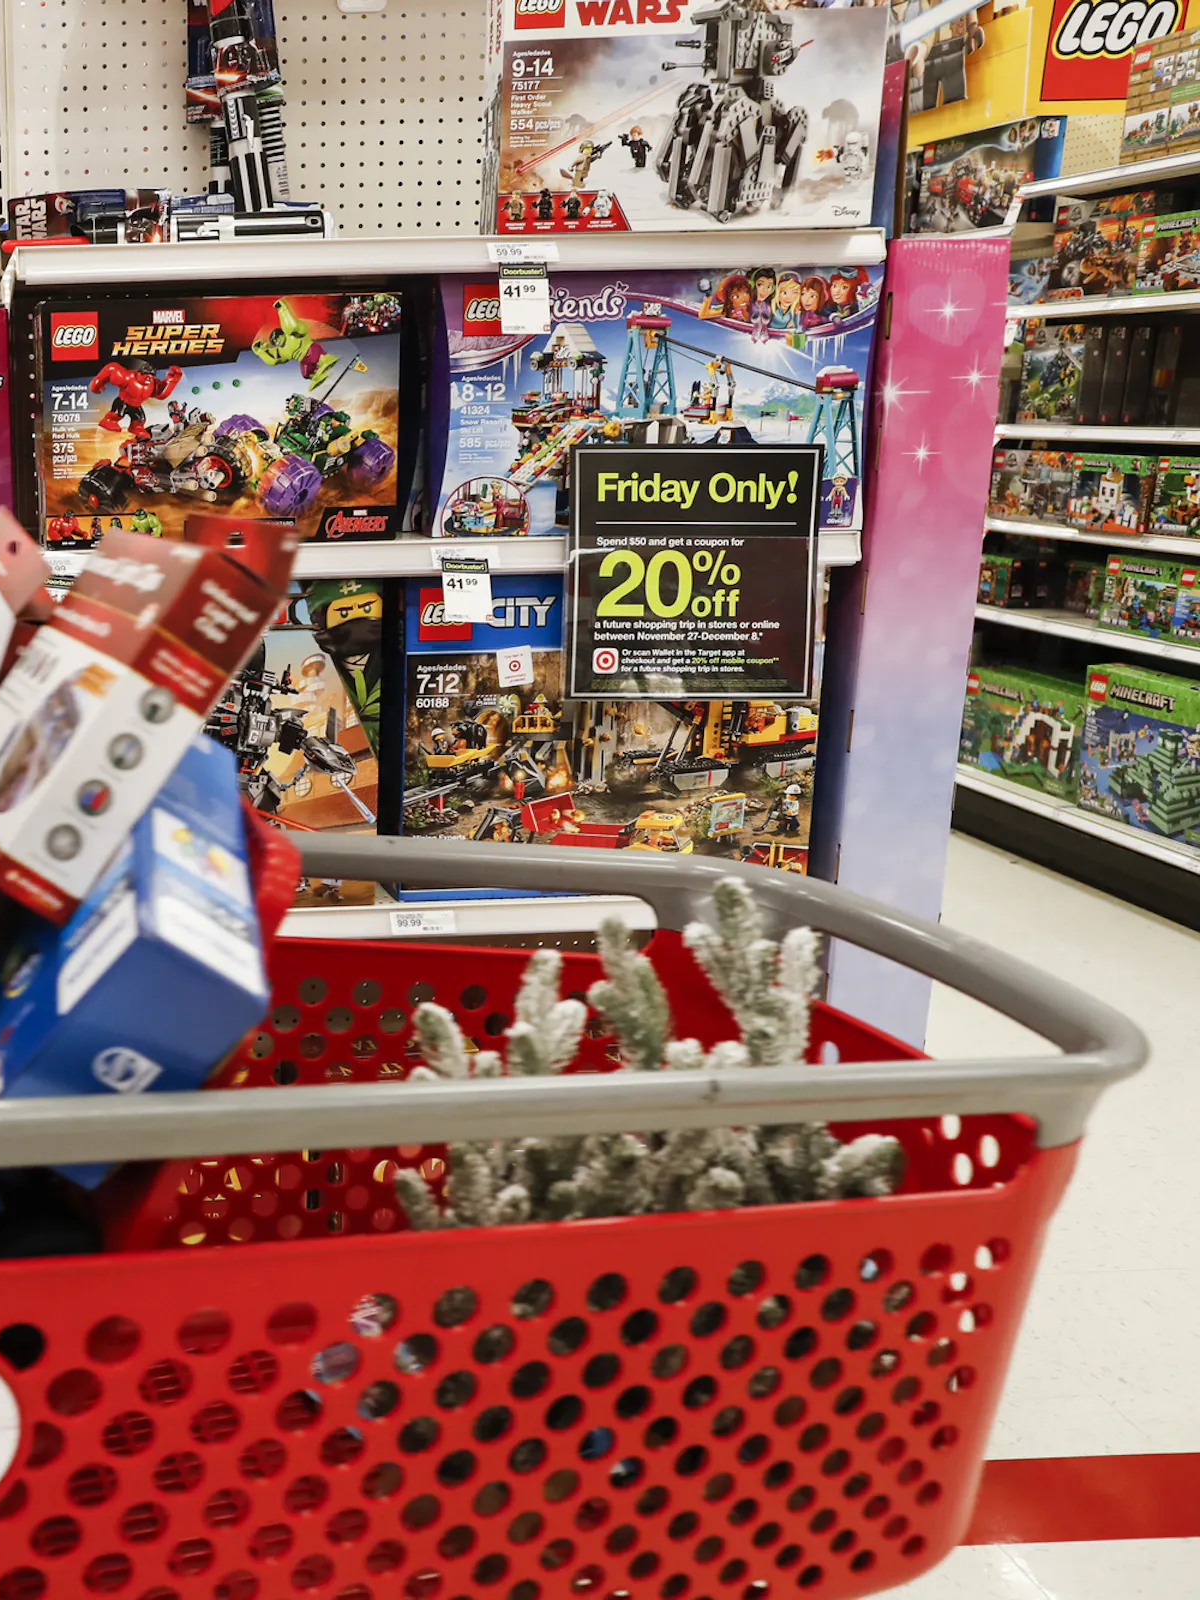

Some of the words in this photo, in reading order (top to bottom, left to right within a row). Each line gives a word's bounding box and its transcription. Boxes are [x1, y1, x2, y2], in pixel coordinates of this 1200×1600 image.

[576, 0, 689, 26] WARS
[1058, 1, 1176, 52] LEGO
[512, 57, 554, 78] 9-14
[511, 81, 540, 91] 75177
[527, 93, 547, 101] Order
[510, 119, 533, 131] 554
[831, 205, 860, 218] Disney
[496, 248, 522, 257] 59.99
[503, 268, 543, 276] Doorbuster!
[503, 285, 521, 298] 41
[523, 285, 536, 293] 99
[153, 310, 185, 323] MARVEL
[466, 301, 500, 321] LEG
[54, 326, 95, 346] LEGO
[125, 324, 221, 341] SUPER
[111, 339, 225, 356] HEROES
[461, 383, 506, 402] 8-12
[51, 392, 89, 411] 7-14
[460, 405, 490, 415] 41324
[52, 413, 80, 423] 76078
[52, 442, 75, 454] 375
[459, 437, 481, 448] 585
[597, 472, 700, 509] Friday
[708, 470, 799, 510] Only!
[325, 510, 389, 538] AVENGERS
[596, 536, 628, 547] Spend
[629, 537, 646, 546] $50
[648, 537, 667, 546] and
[668, 537, 684, 548] get
[686, 538, 692, 546] a
[693, 538, 730, 548] coupon
[731, 537, 745, 546] for
[445, 562, 484, 571] Doorbuster!
[446, 578, 463, 590] 41
[596, 549, 742, 618] 20%
[691, 589, 740, 618] off
[490, 596, 556, 628] CITY
[594, 621, 601, 629] a
[602, 620, 631, 629] future
[633, 620, 677, 631] shopping
[679, 620, 696, 631] trip
[697, 620, 707, 629] in
[708, 620, 737, 629] stores
[751, 620, 780, 629] online
[594, 632, 635, 641] between
[637, 632, 685, 641] November
[687, 632, 748, 641] 27-December
[697, 649, 721, 658] Target
[722, 650, 736, 658] app
[417, 664, 467, 672] Ages/edades
[672, 658, 684, 666] get
[662, 666, 696, 674] shopping
[697, 666, 710, 674] trip
[416, 674, 460, 694] 7-12
[415, 698, 450, 708] 60188
[1110, 684, 1176, 712] MINECRAFT
[397, 919, 422, 928] 99.99
